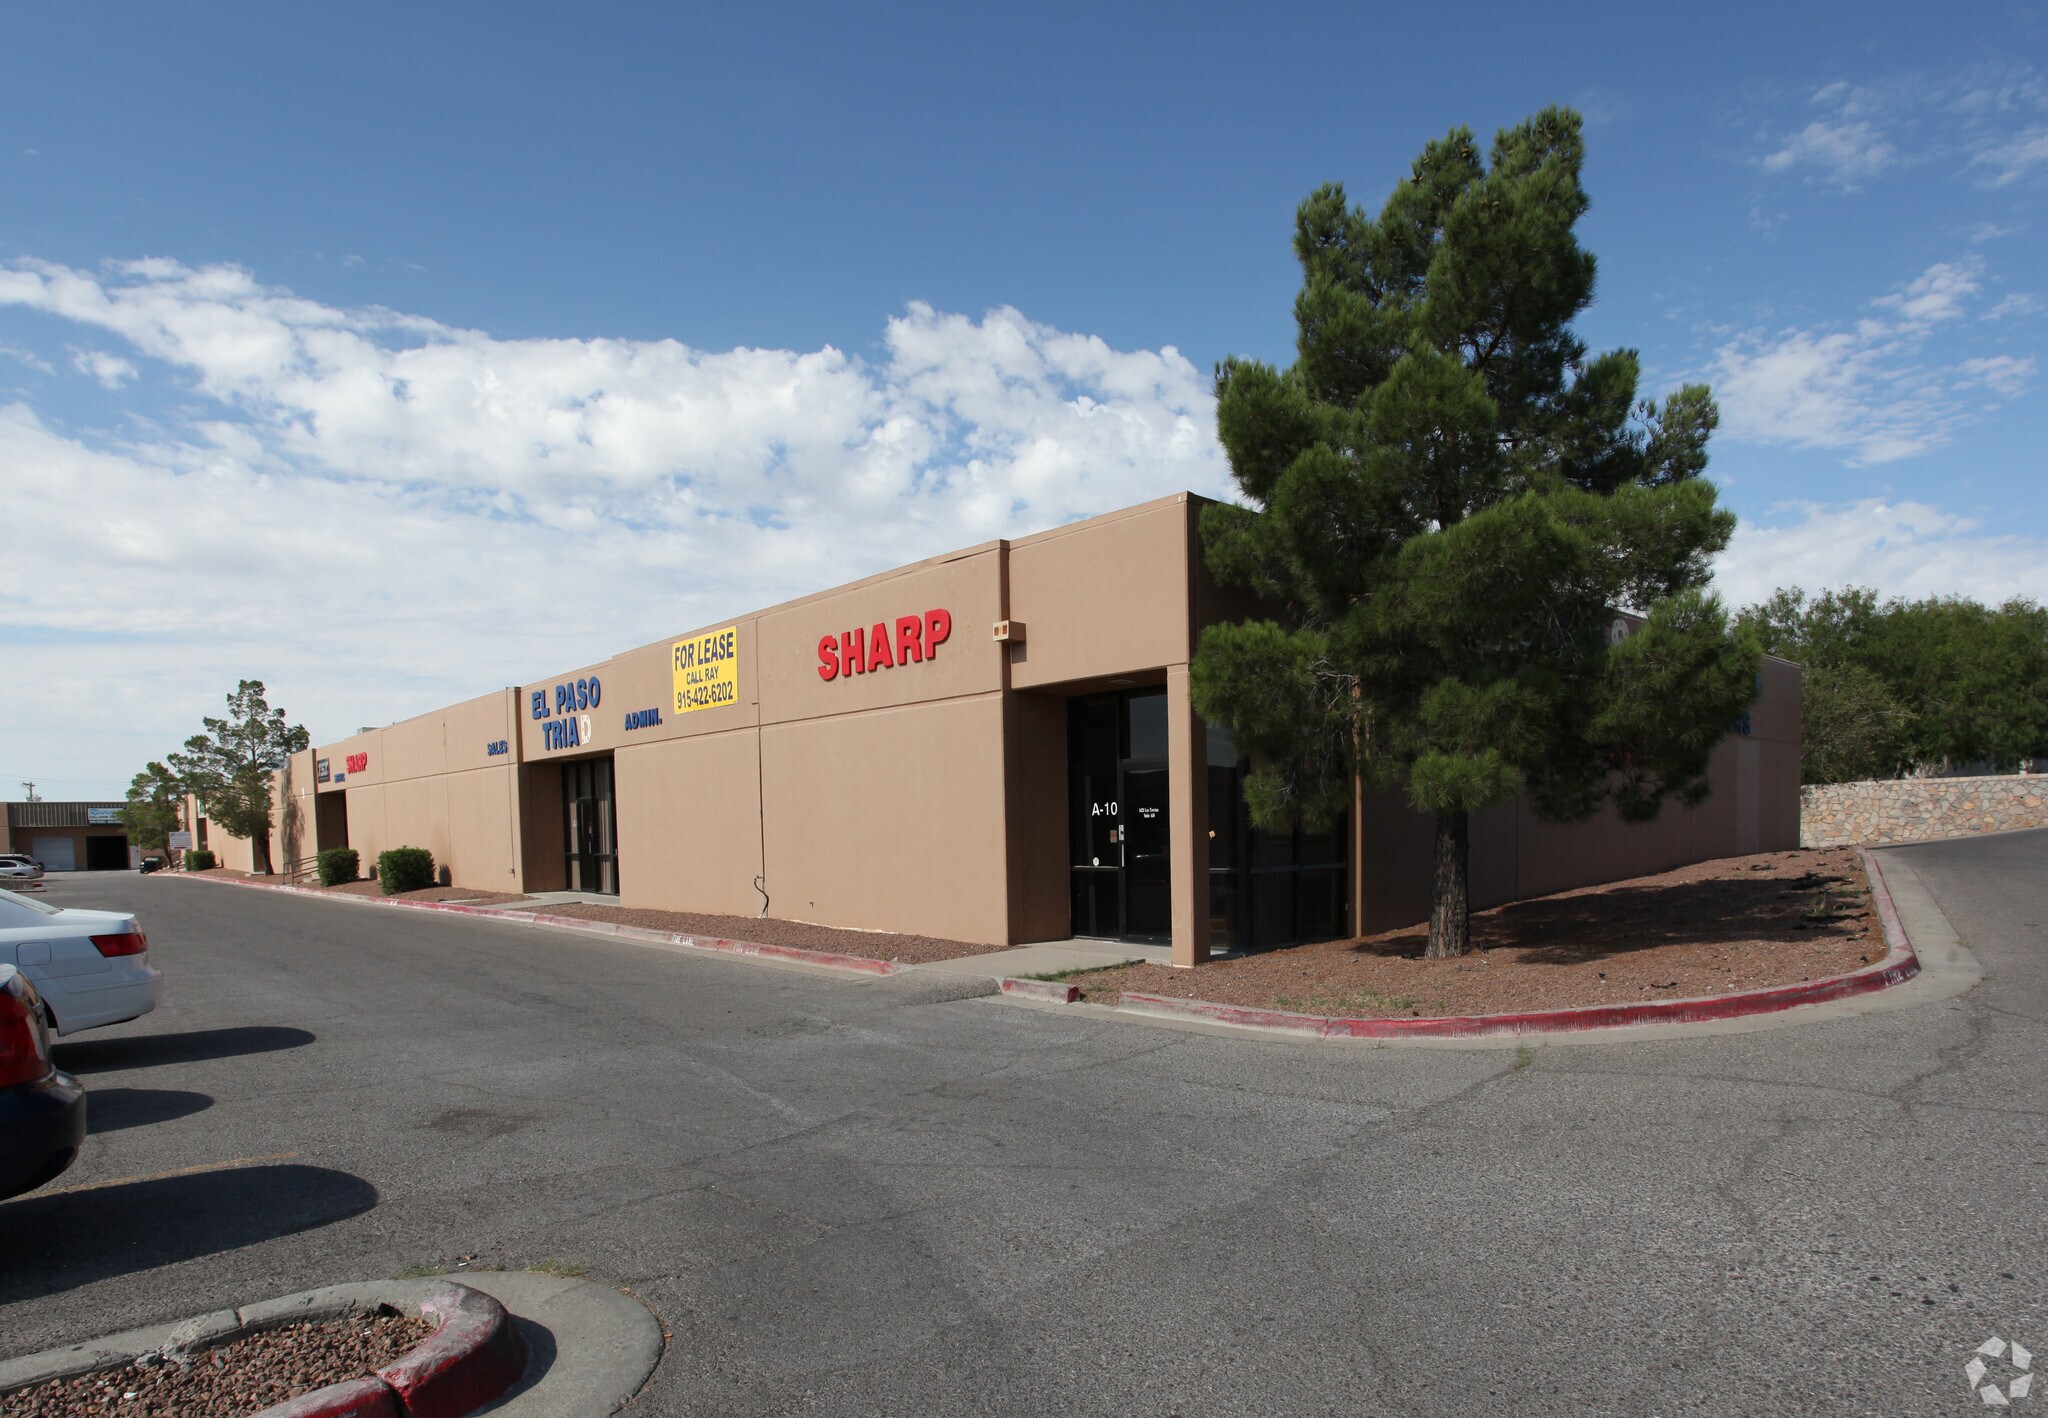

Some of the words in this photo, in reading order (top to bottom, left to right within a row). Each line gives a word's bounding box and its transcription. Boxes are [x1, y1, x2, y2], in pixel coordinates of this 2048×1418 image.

[675, 643, 694, 671] FOR
[698, 632, 734, 665] LEASE
[818, 608, 951, 682] SHARP
[686, 670, 703, 685] CALL
[705, 665, 719, 681] RAY
[532, 689, 550, 720] EL
[555, 676, 601, 715] PASO
[677, 681, 734, 709] 915-422-6202
[542, 714, 592, 751] TRIAD
[625, 707, 663, 731] ADMIN.
[1091, 801, 1118, 816] A-10
